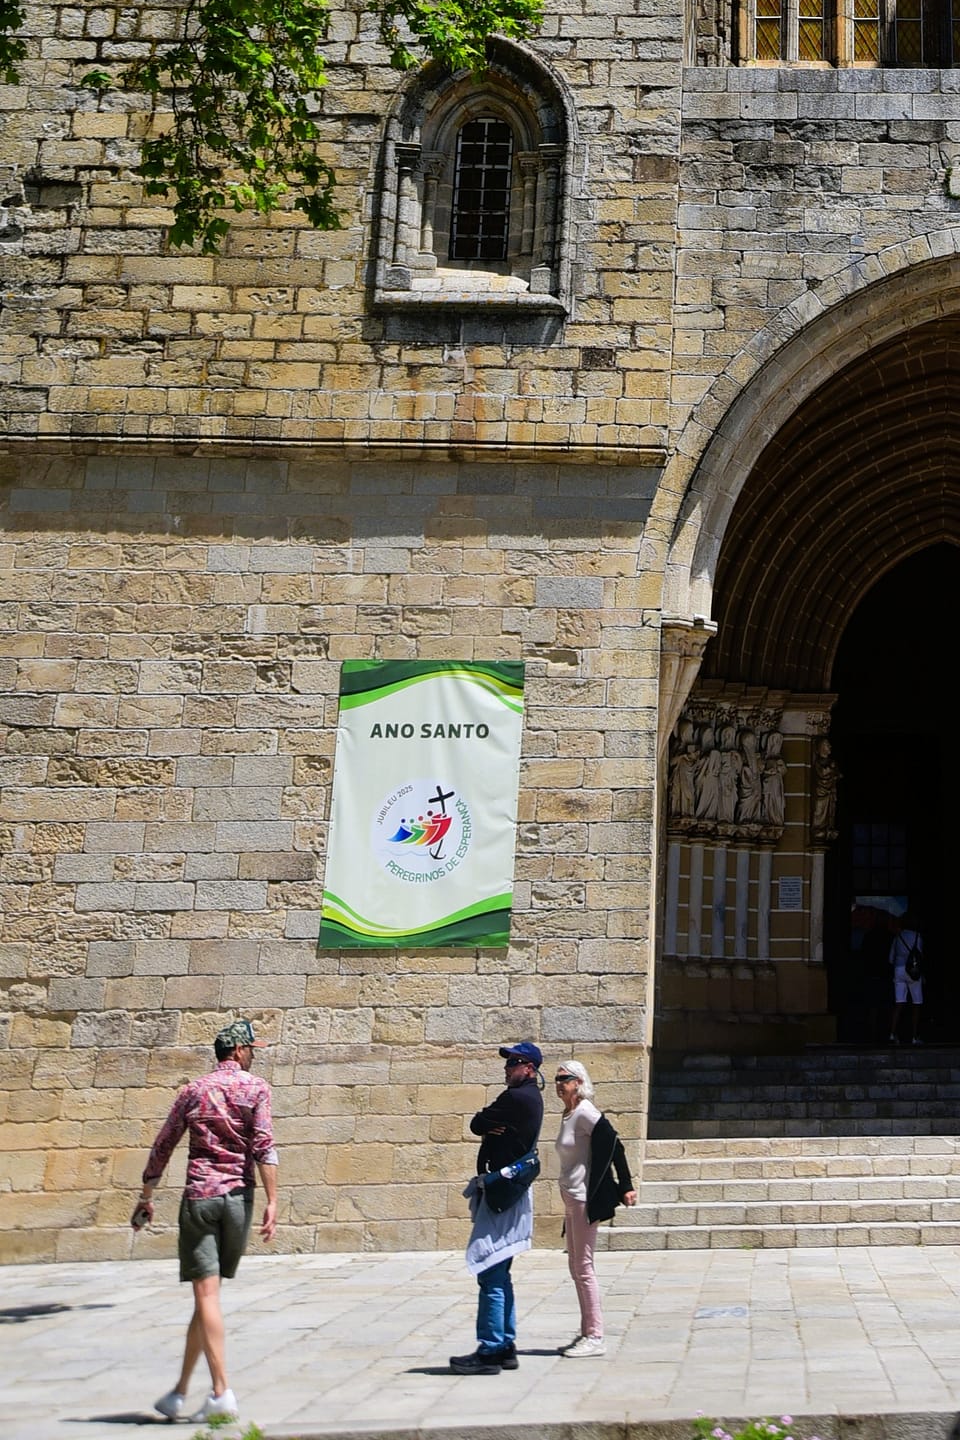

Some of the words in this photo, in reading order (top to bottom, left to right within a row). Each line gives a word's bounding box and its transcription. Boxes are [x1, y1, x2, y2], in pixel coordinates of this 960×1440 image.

[370, 723, 414, 739] ANO
[420, 723, 490, 739] SANTO
[377, 796, 397, 825] JUBILEU
[397, 785, 414, 798] 2025
[385, 860, 446, 883] PEREGRINOS
[445, 857, 460, 871] DE
[455, 798, 472, 858] ESPERANÇA
